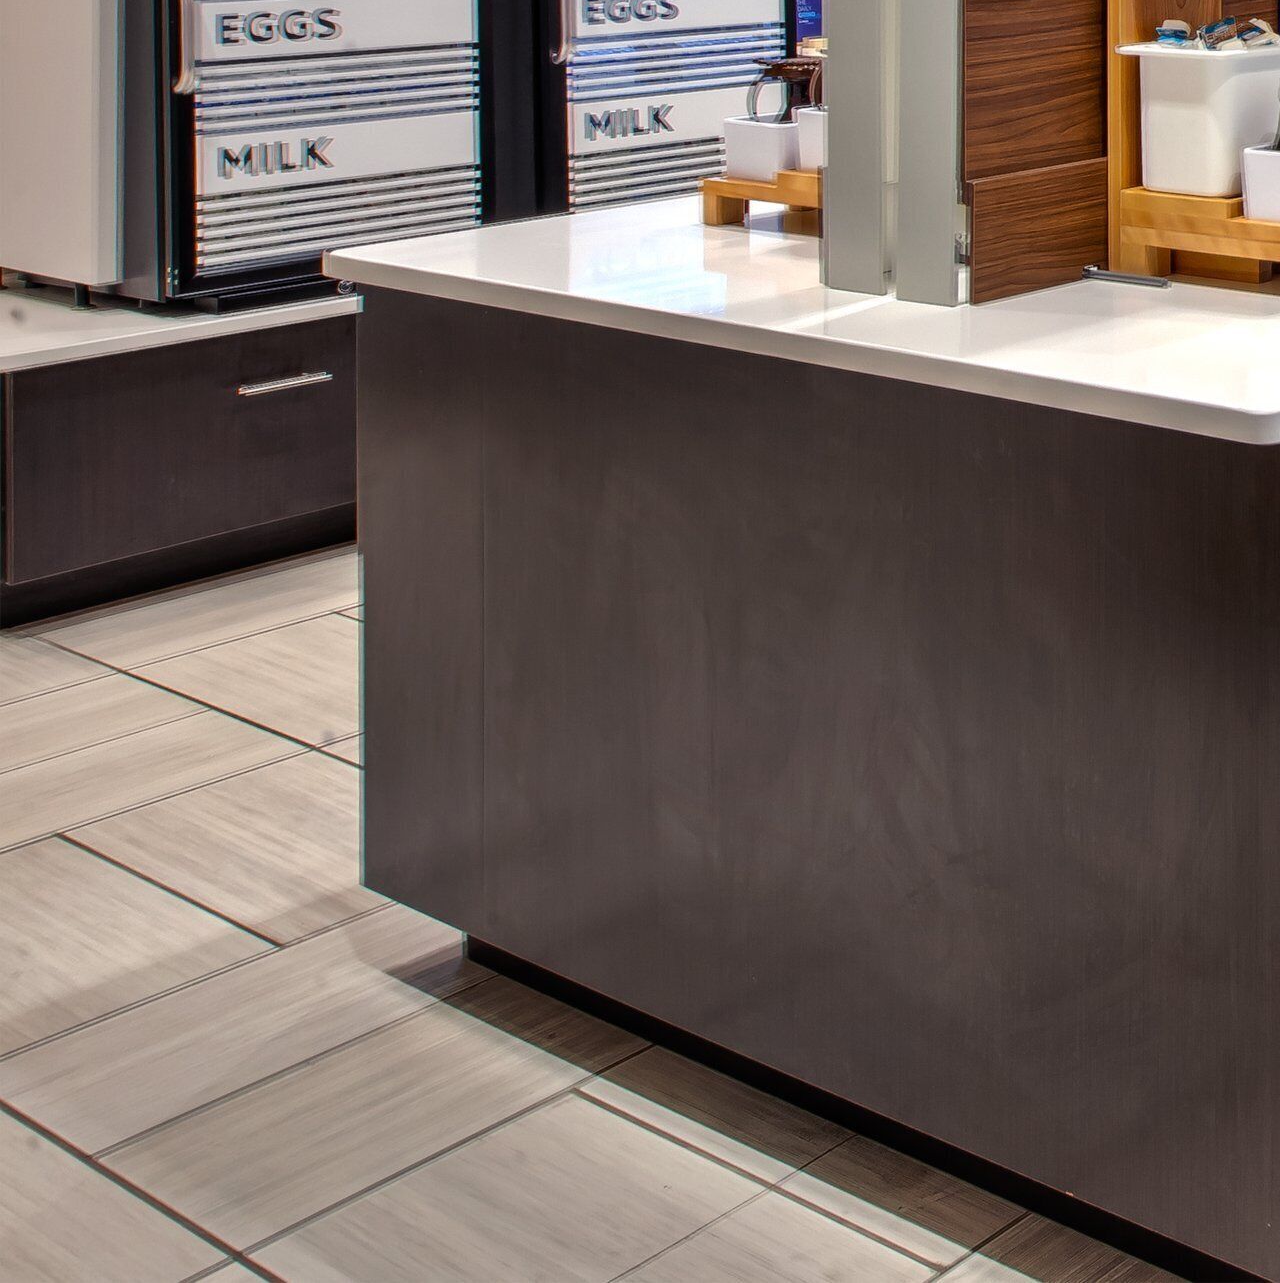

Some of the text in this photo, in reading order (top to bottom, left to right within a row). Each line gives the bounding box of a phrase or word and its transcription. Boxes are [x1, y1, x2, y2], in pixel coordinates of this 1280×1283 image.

[215, 8, 343, 47] EGGS
[584, 104, 675, 141] MILK
[217, 136, 335, 179] MILK
